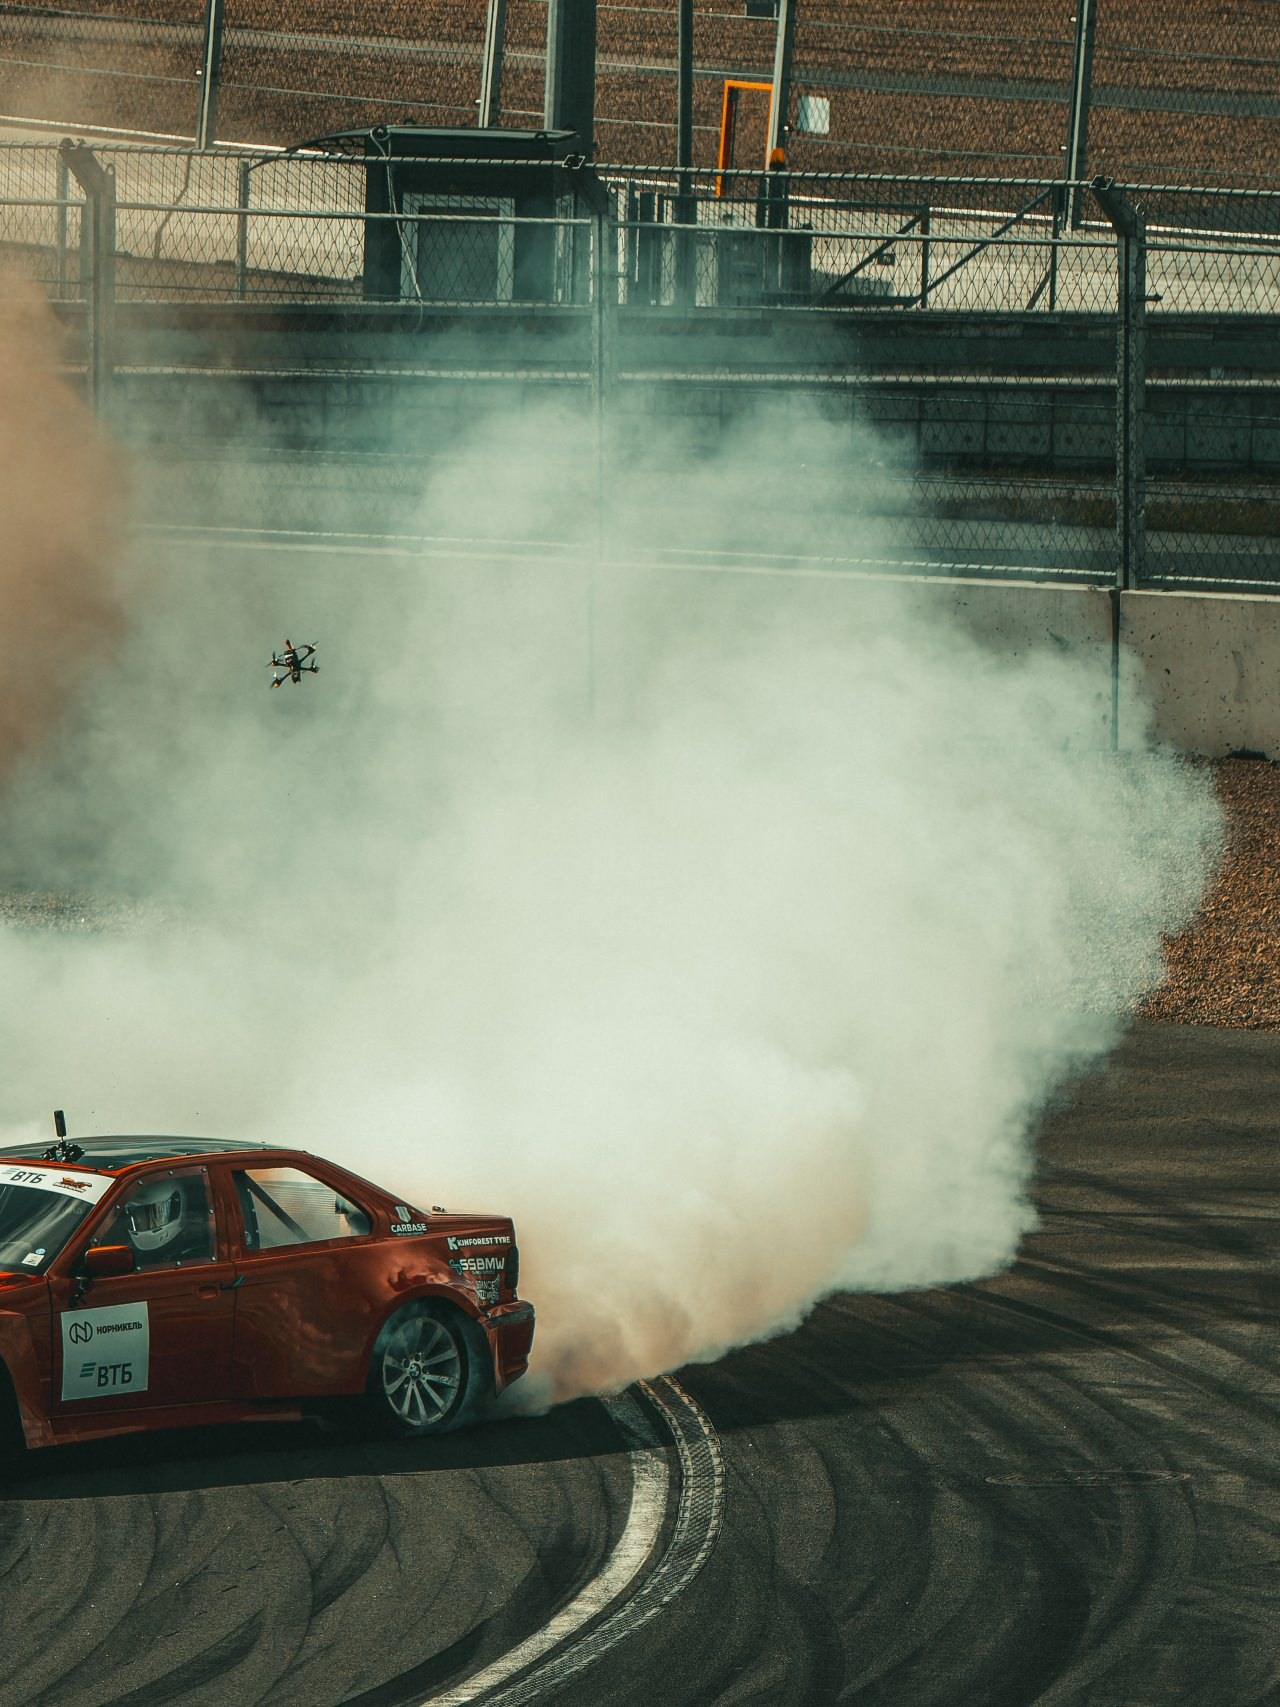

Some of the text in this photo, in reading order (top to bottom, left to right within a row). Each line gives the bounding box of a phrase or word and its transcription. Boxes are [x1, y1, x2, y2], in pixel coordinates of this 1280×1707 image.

[10, 1171, 47, 1184] ВТБ
[391, 1223, 427, 1232] CARBASE
[457, 1238, 493, 1246] KINFOREST
[494, 1236, 511, 1244] TYRE
[460, 1257, 505, 1271] SSBMW
[96, 1321, 142, 1334] НОРНИКЕЛЬ
[97, 1363, 132, 1387] ВТБ
